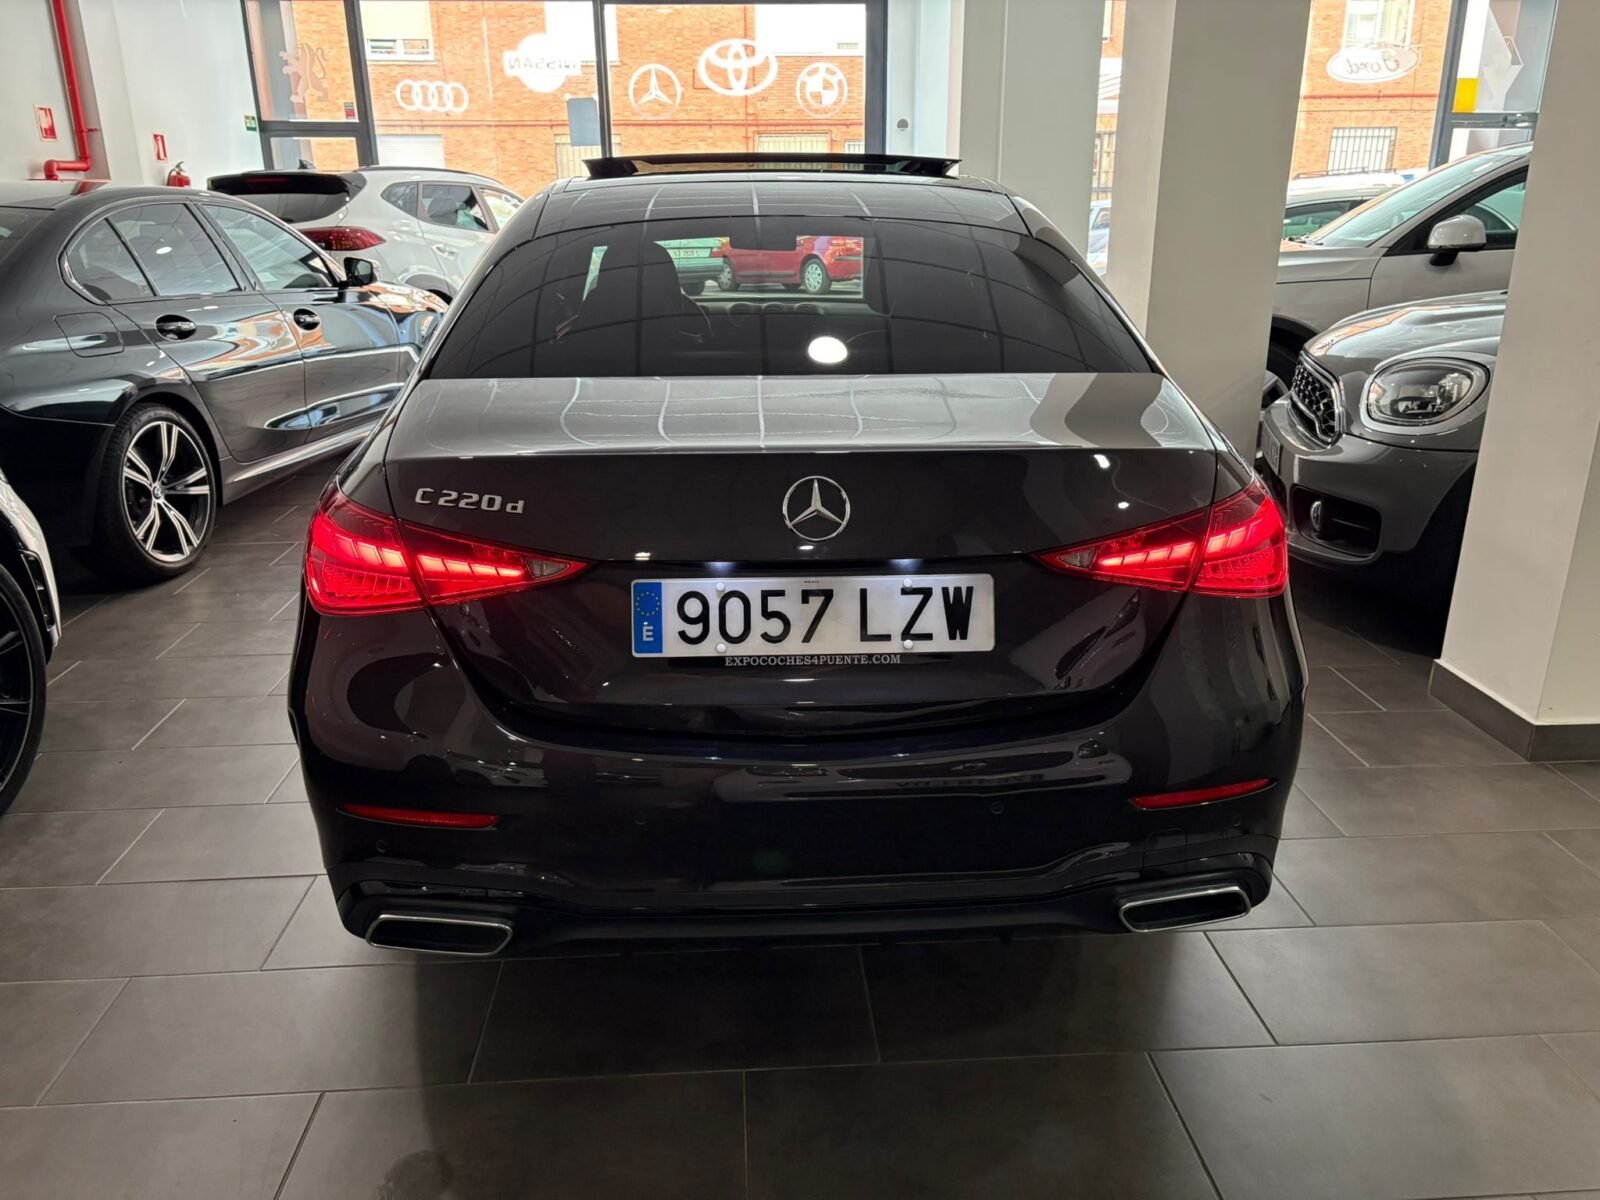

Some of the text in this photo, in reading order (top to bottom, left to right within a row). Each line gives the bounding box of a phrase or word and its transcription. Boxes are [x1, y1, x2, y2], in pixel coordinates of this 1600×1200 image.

[415, 487, 525, 514] C 220 d
[676, 585, 974, 645] 9057 LZW
[642, 626, 654, 642] E
[724, 654, 901, 666] EXPOCOCHES4PUENTE.COM
